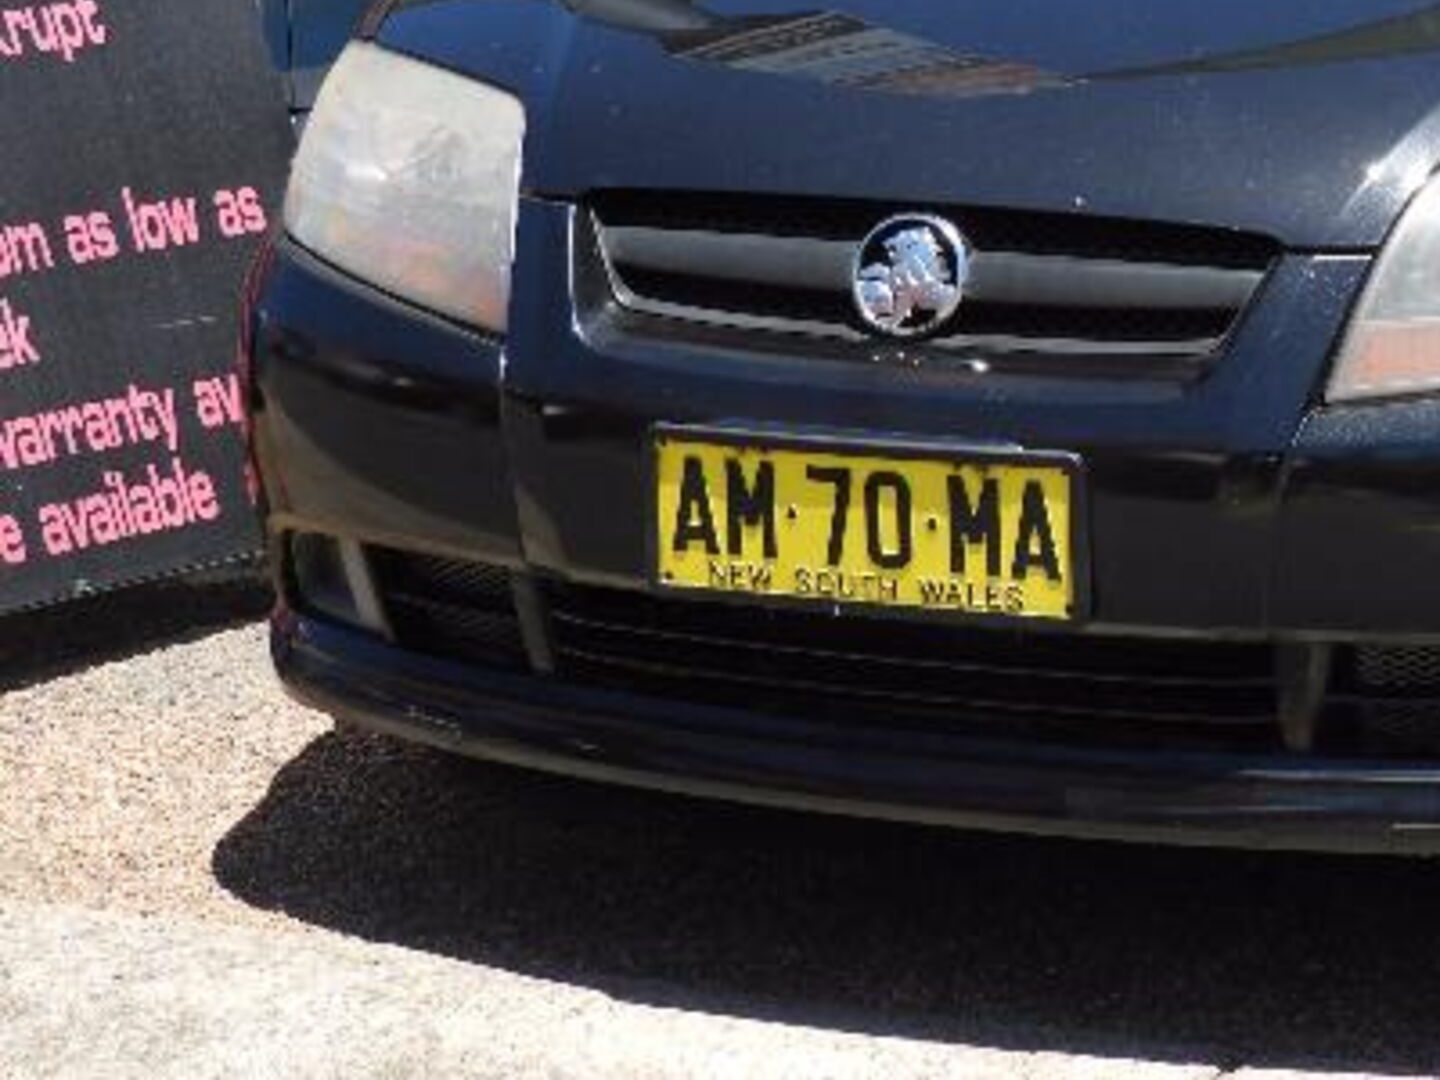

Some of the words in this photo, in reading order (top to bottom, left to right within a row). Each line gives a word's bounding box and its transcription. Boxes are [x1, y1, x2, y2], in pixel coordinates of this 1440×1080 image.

[64, 211, 119, 263] as
[122, 186, 200, 253] low
[215, 186, 268, 237] as
[39, 458, 221, 555] available
[709, 560, 775, 590] NEW
[794, 567, 900, 600] SOUTH
[919, 578, 1025, 612] WALES
